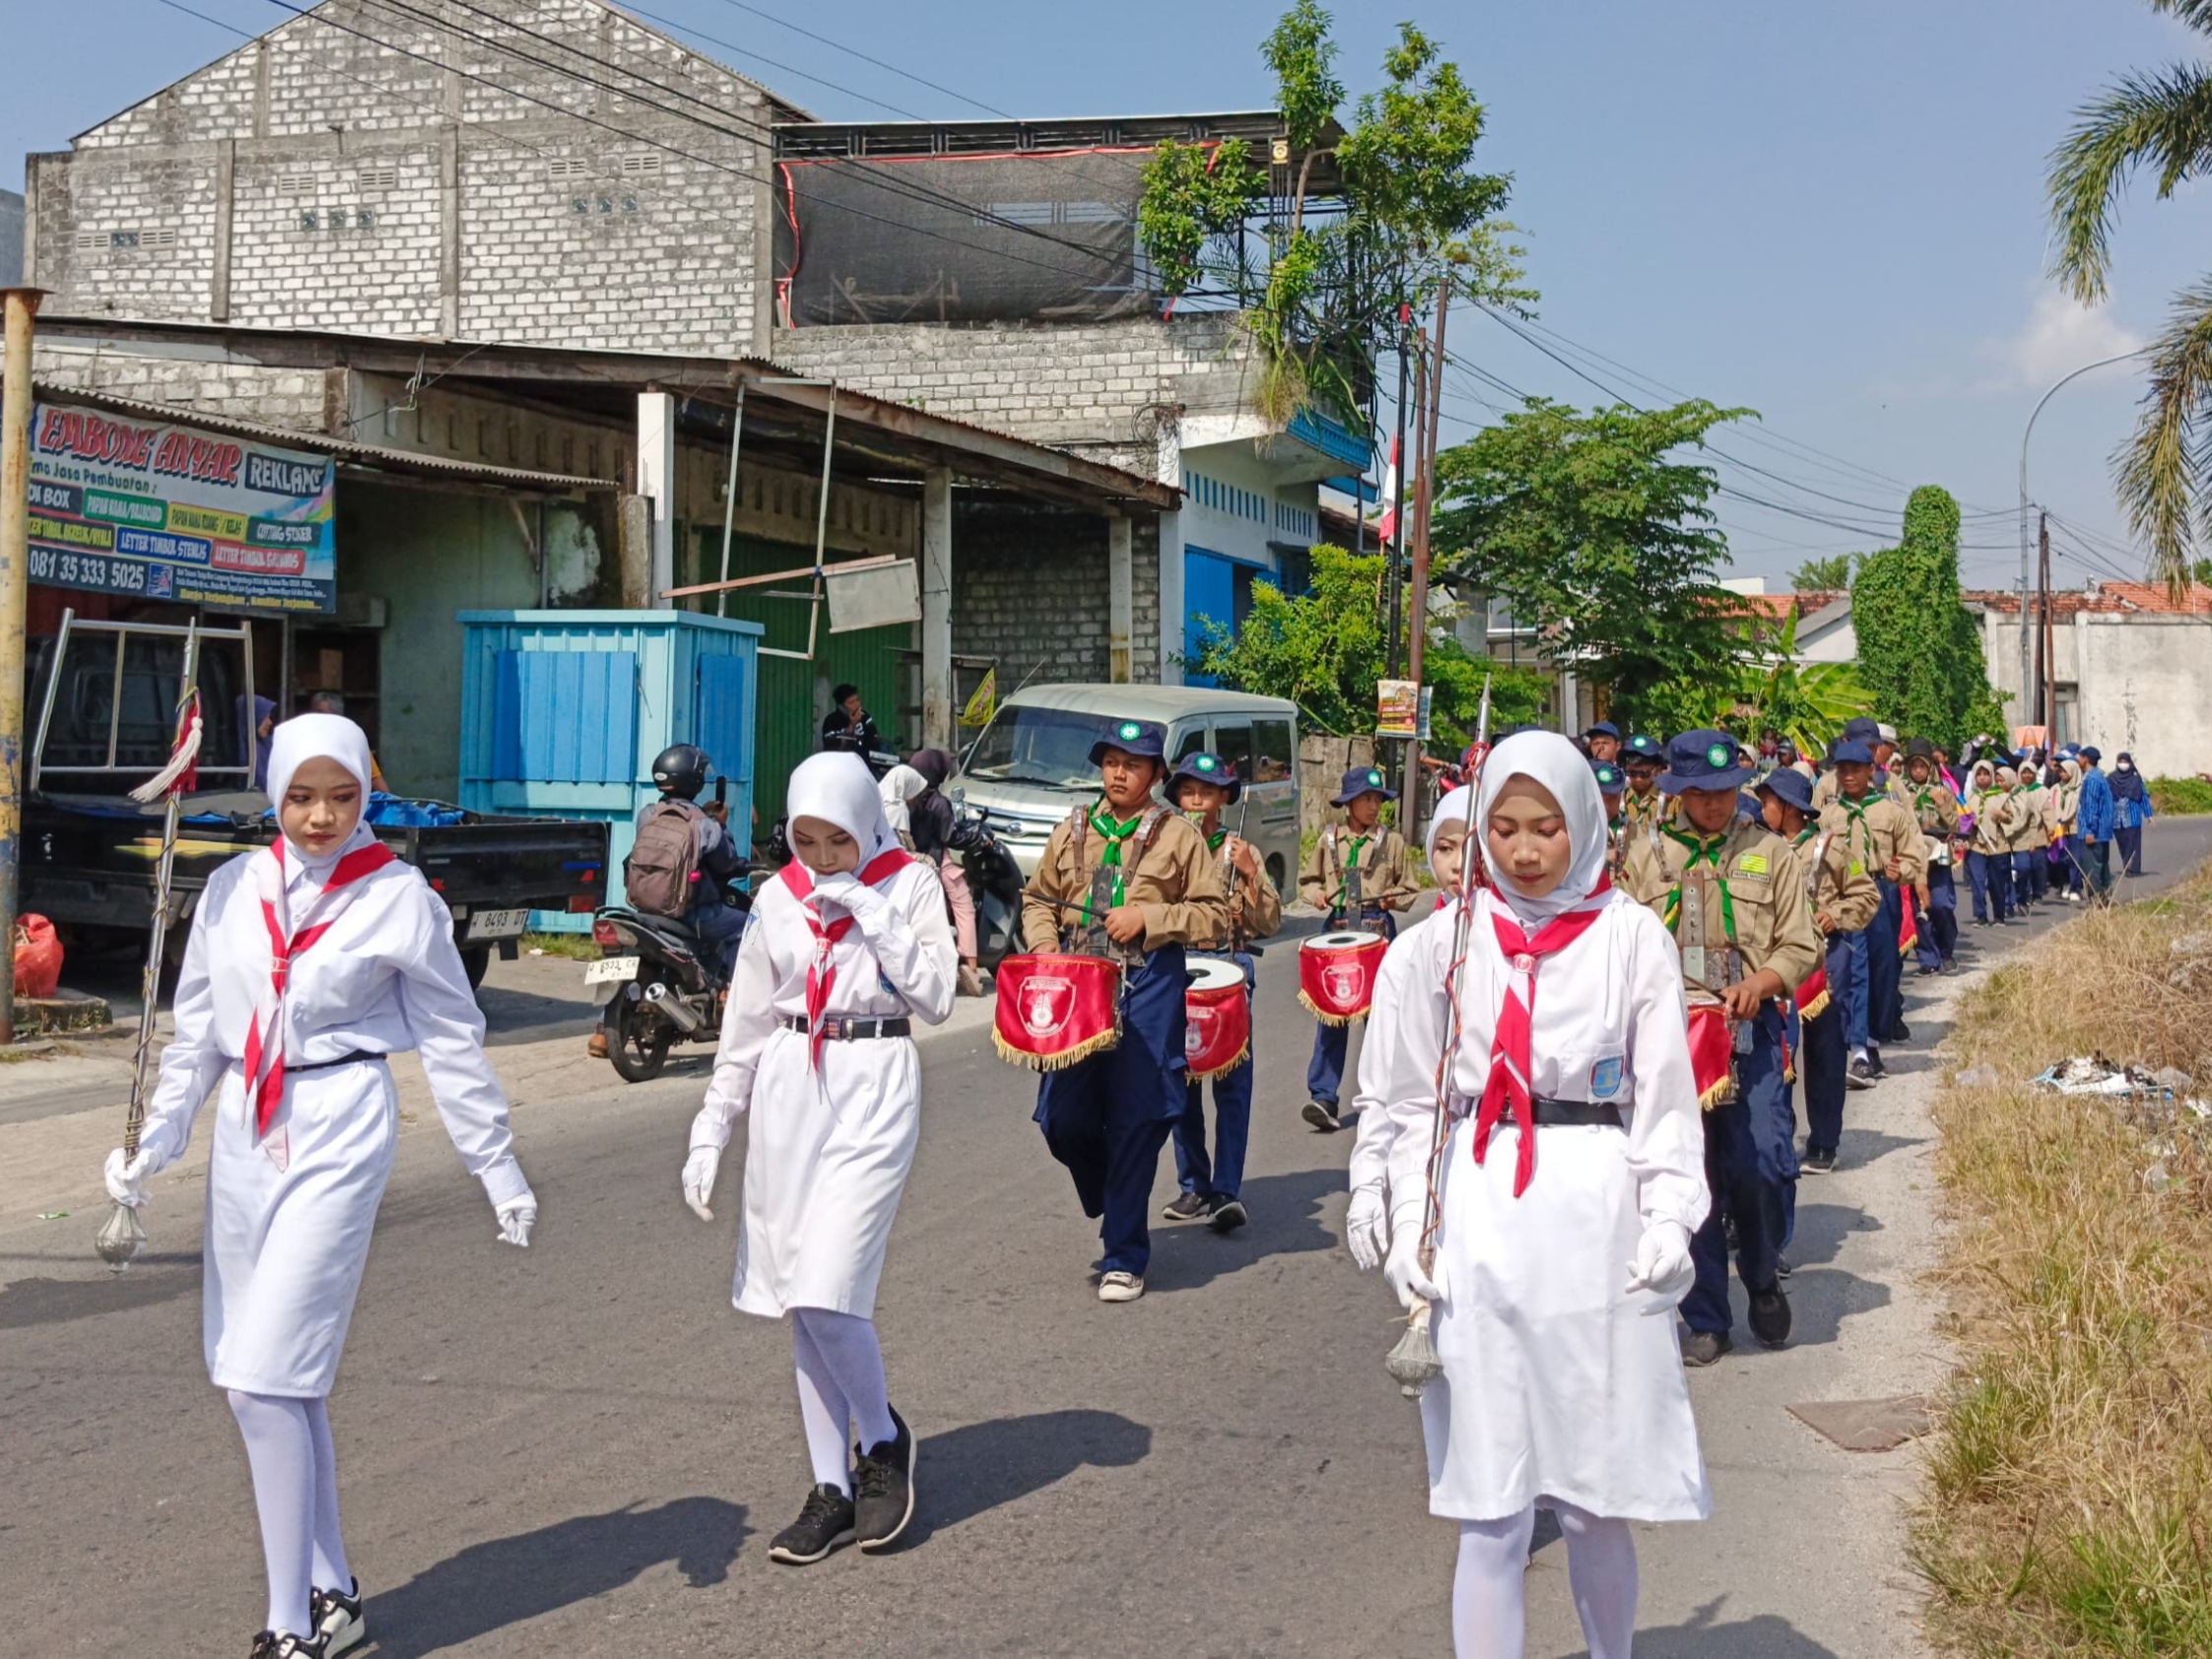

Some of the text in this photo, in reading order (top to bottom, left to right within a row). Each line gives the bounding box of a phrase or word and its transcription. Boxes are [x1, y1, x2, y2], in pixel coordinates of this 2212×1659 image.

[39, 408, 242, 489] EMBONG ANYAR
[32, 461, 50, 475] ma
[53, 463, 81, 481] Jasa
[84, 469, 150, 493] Pembuatan
[29, 484, 71, 508] ON BOX
[120, 532, 148, 551] LETTER
[215, 545, 238, 564] LETTER
[30, 550, 57, 578] 081
[59, 555, 78, 581] 35
[81, 558, 105, 585] 333
[111, 562, 145, 590] 5025
[485, 911, 509, 928] 8493
[514, 910, 528, 926] DT
